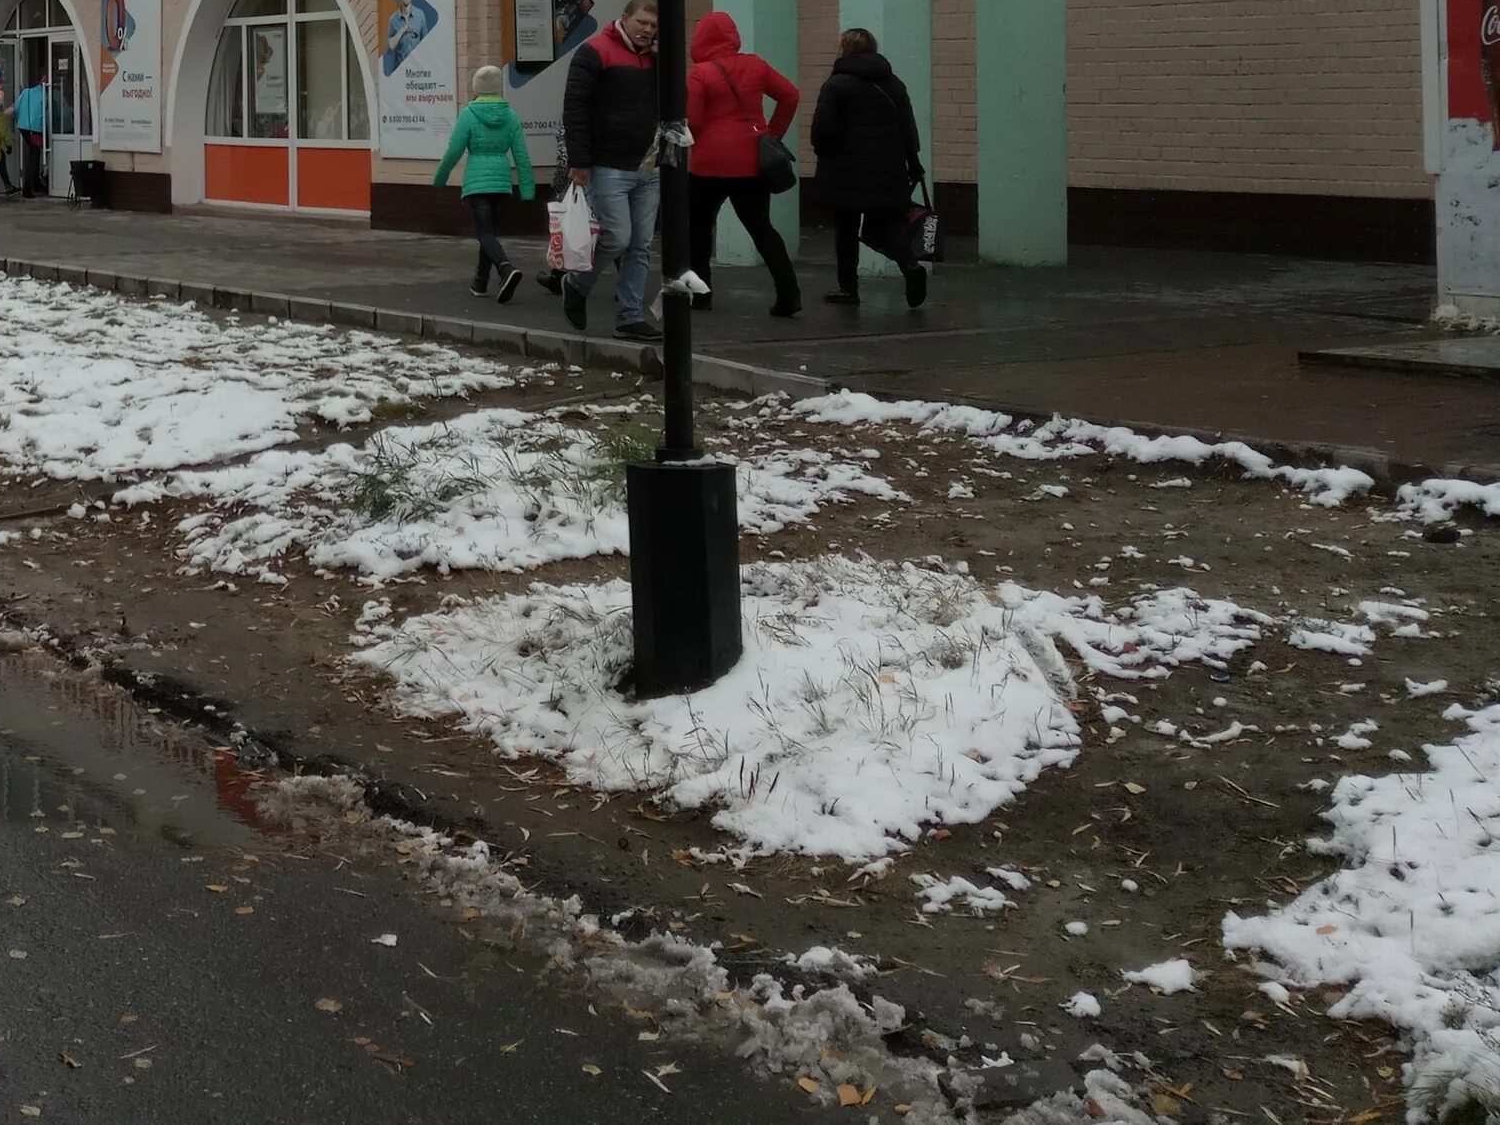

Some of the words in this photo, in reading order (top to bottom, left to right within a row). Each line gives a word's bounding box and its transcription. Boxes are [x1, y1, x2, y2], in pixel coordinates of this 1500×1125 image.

[128, 72, 144, 82] нами
[406, 69, 431, 78] Многие
[406, 81, 437, 91] обещают
[122, 86, 152, 99] выгодно!
[406, 94, 417, 102] мы
[419, 93, 453, 104] выручаем
[534, 121, 547, 129] 700
